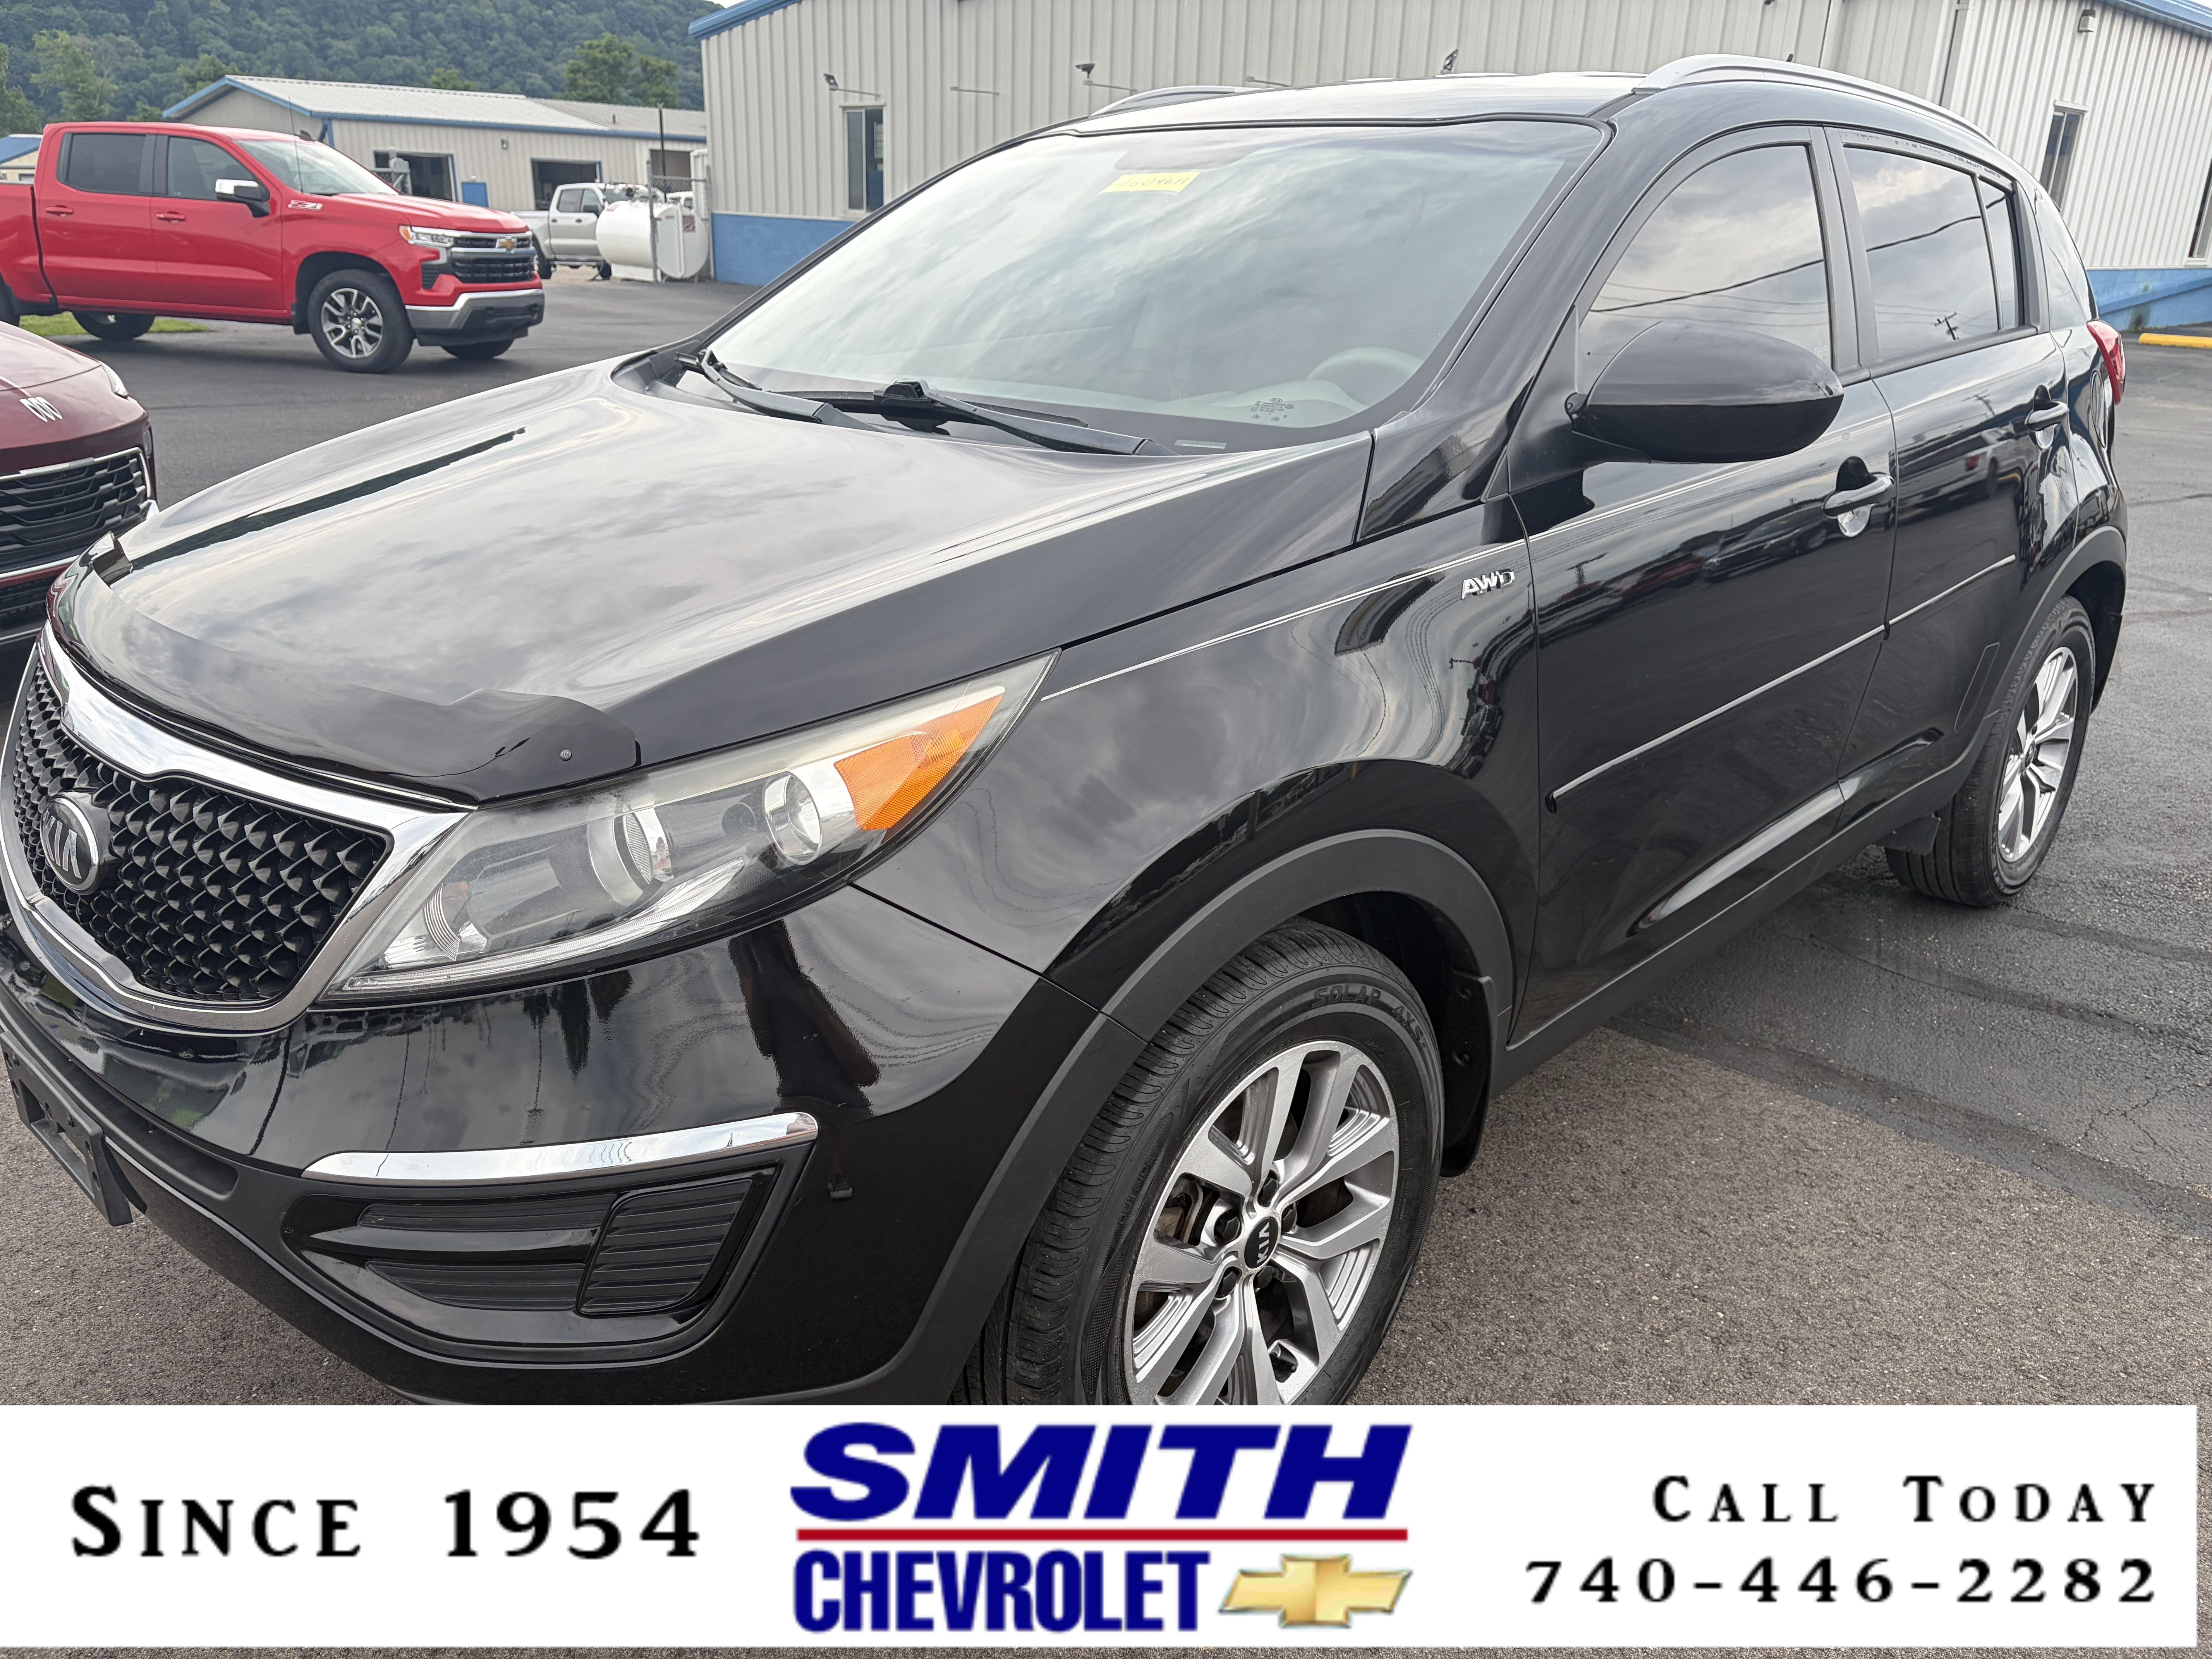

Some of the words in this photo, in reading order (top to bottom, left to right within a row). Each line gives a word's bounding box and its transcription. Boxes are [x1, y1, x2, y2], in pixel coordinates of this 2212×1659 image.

[1461, 571, 1515, 599] AWD
[43, 810, 82, 879] KIA
[1311, 984, 1382, 1008] SOLAR
[1256, 1222, 1270, 1265] KIA
